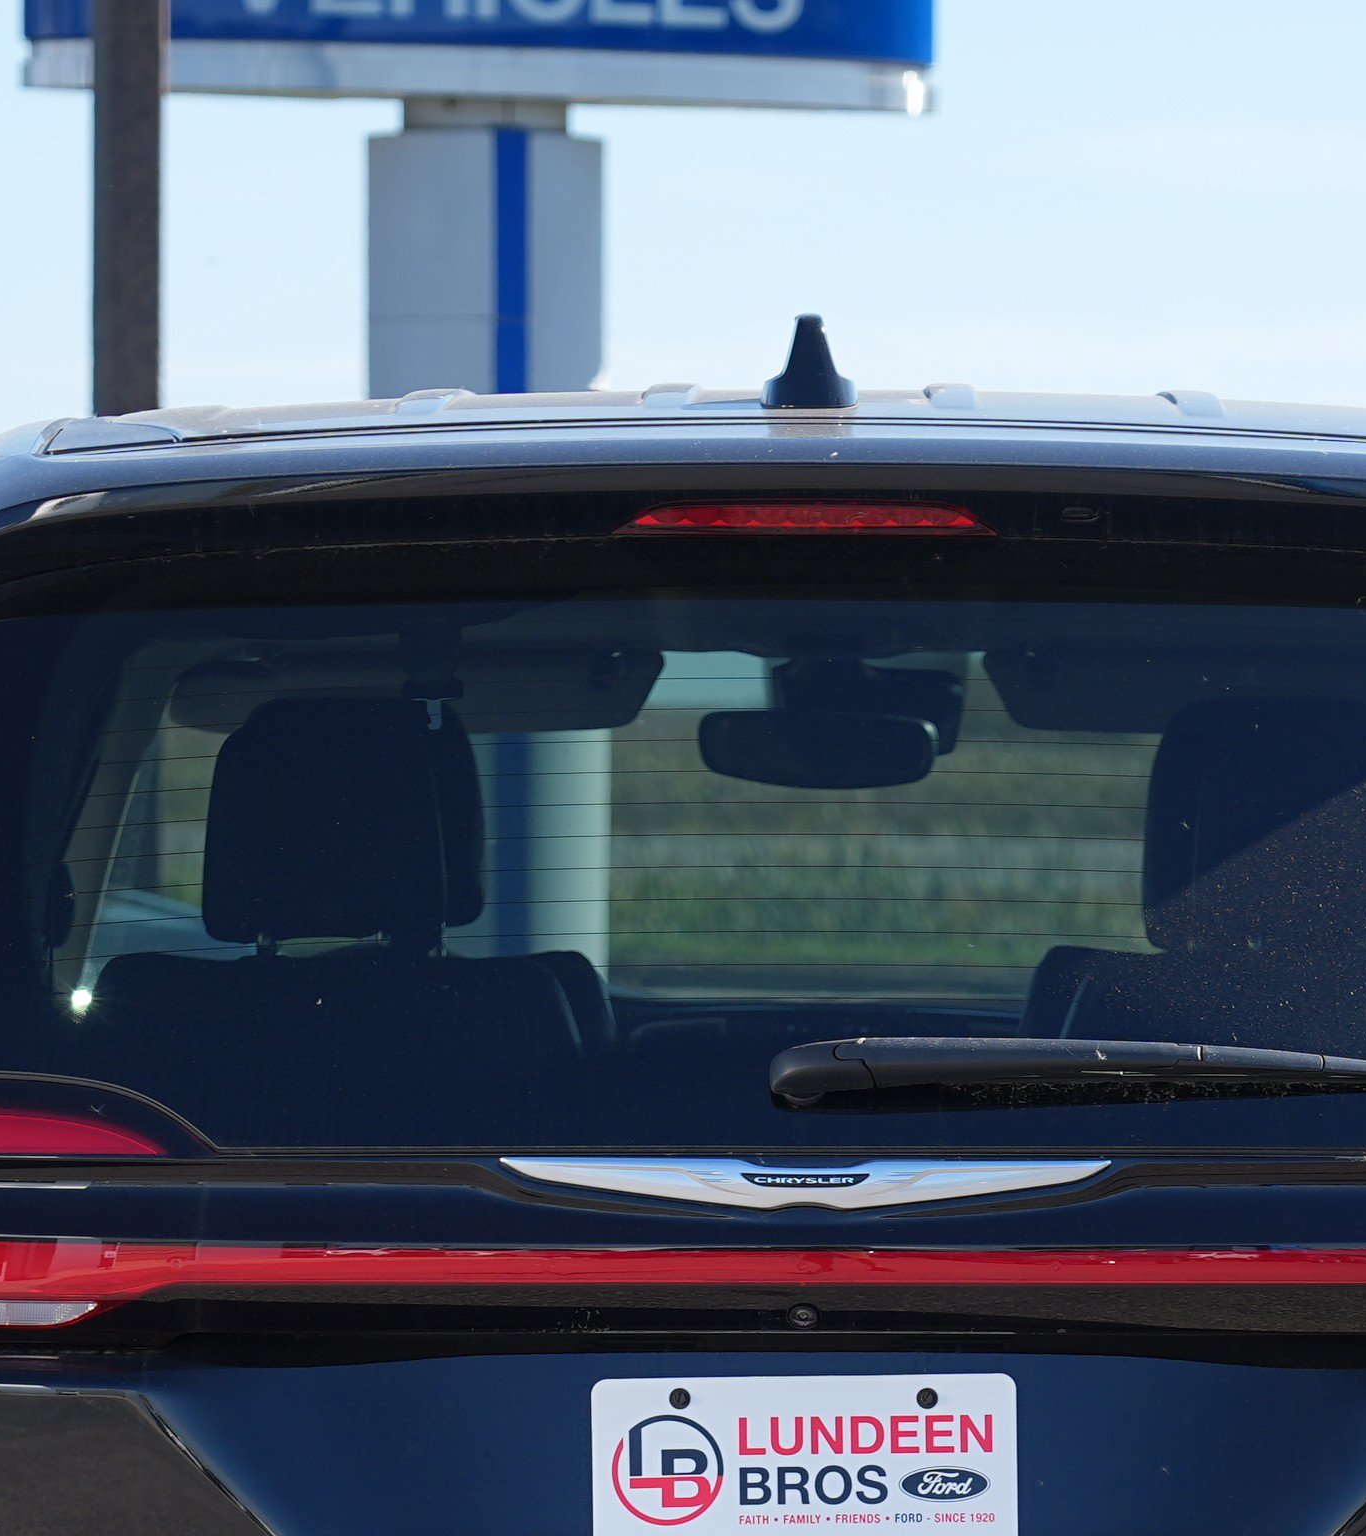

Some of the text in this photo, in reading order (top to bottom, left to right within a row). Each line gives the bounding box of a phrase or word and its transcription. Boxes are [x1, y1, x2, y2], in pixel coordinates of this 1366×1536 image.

[753, 1175, 854, 1184] CHRYSLER
[738, 1414, 993, 1456] LUNDEEN
[738, 1464, 889, 1506] BROS
[916, 1471, 973, 1496] Ford
[739, 1512, 995, 1525] FAITH FAMILY FRIENDS FORD SINCE 1920
